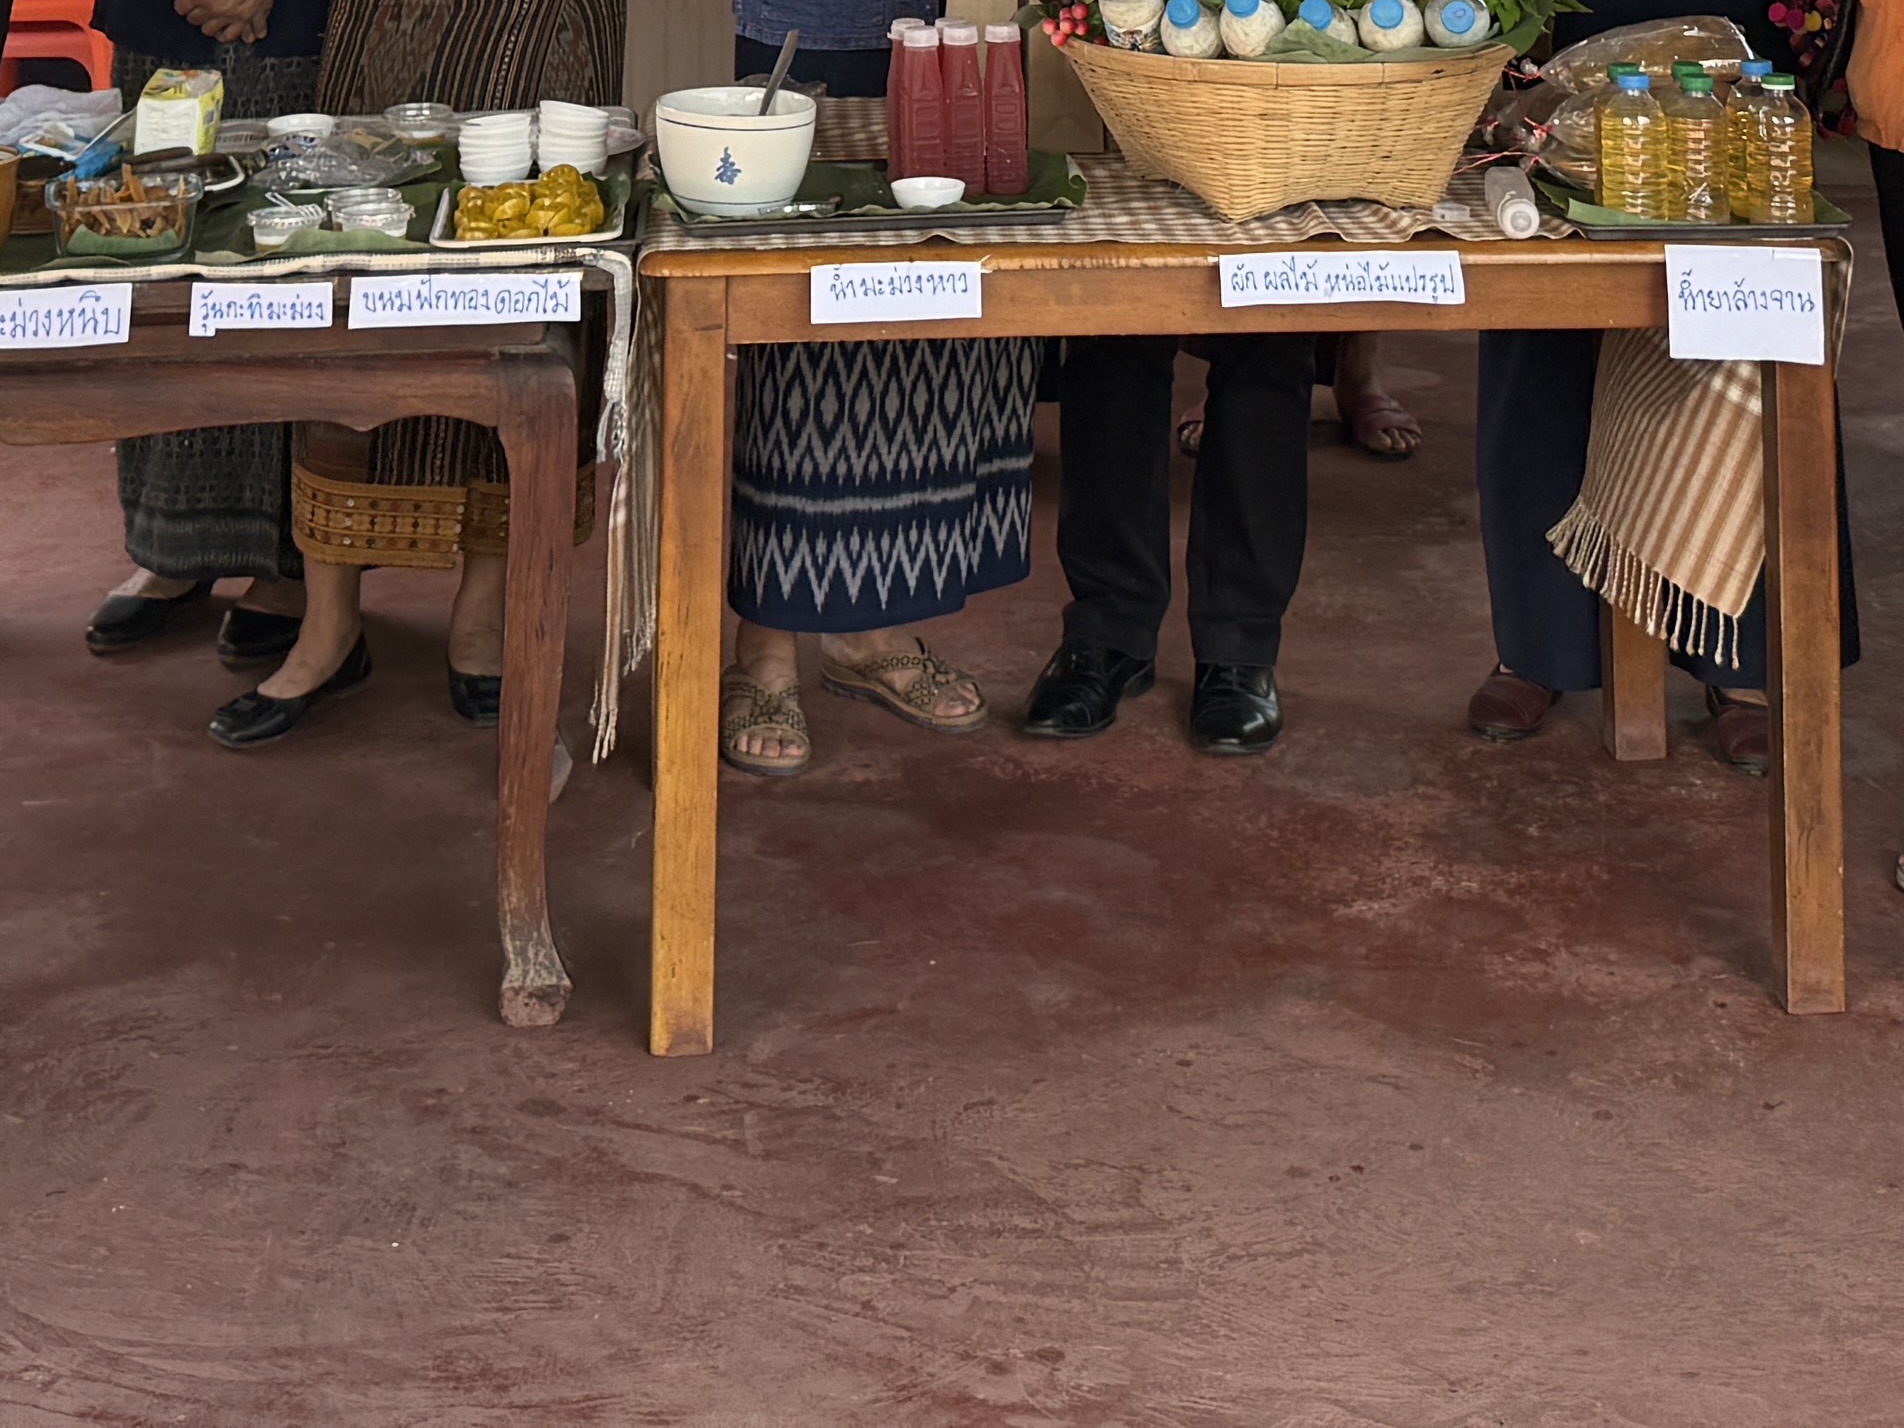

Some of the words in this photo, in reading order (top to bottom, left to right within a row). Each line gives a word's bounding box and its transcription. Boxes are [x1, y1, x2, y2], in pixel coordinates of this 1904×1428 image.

[1231, 263, 1258, 292] ผัก
[1264, 255, 1318, 292] ผลไม้
[199, 289, 324, 333] วุ้นกะทิมะม่วง
